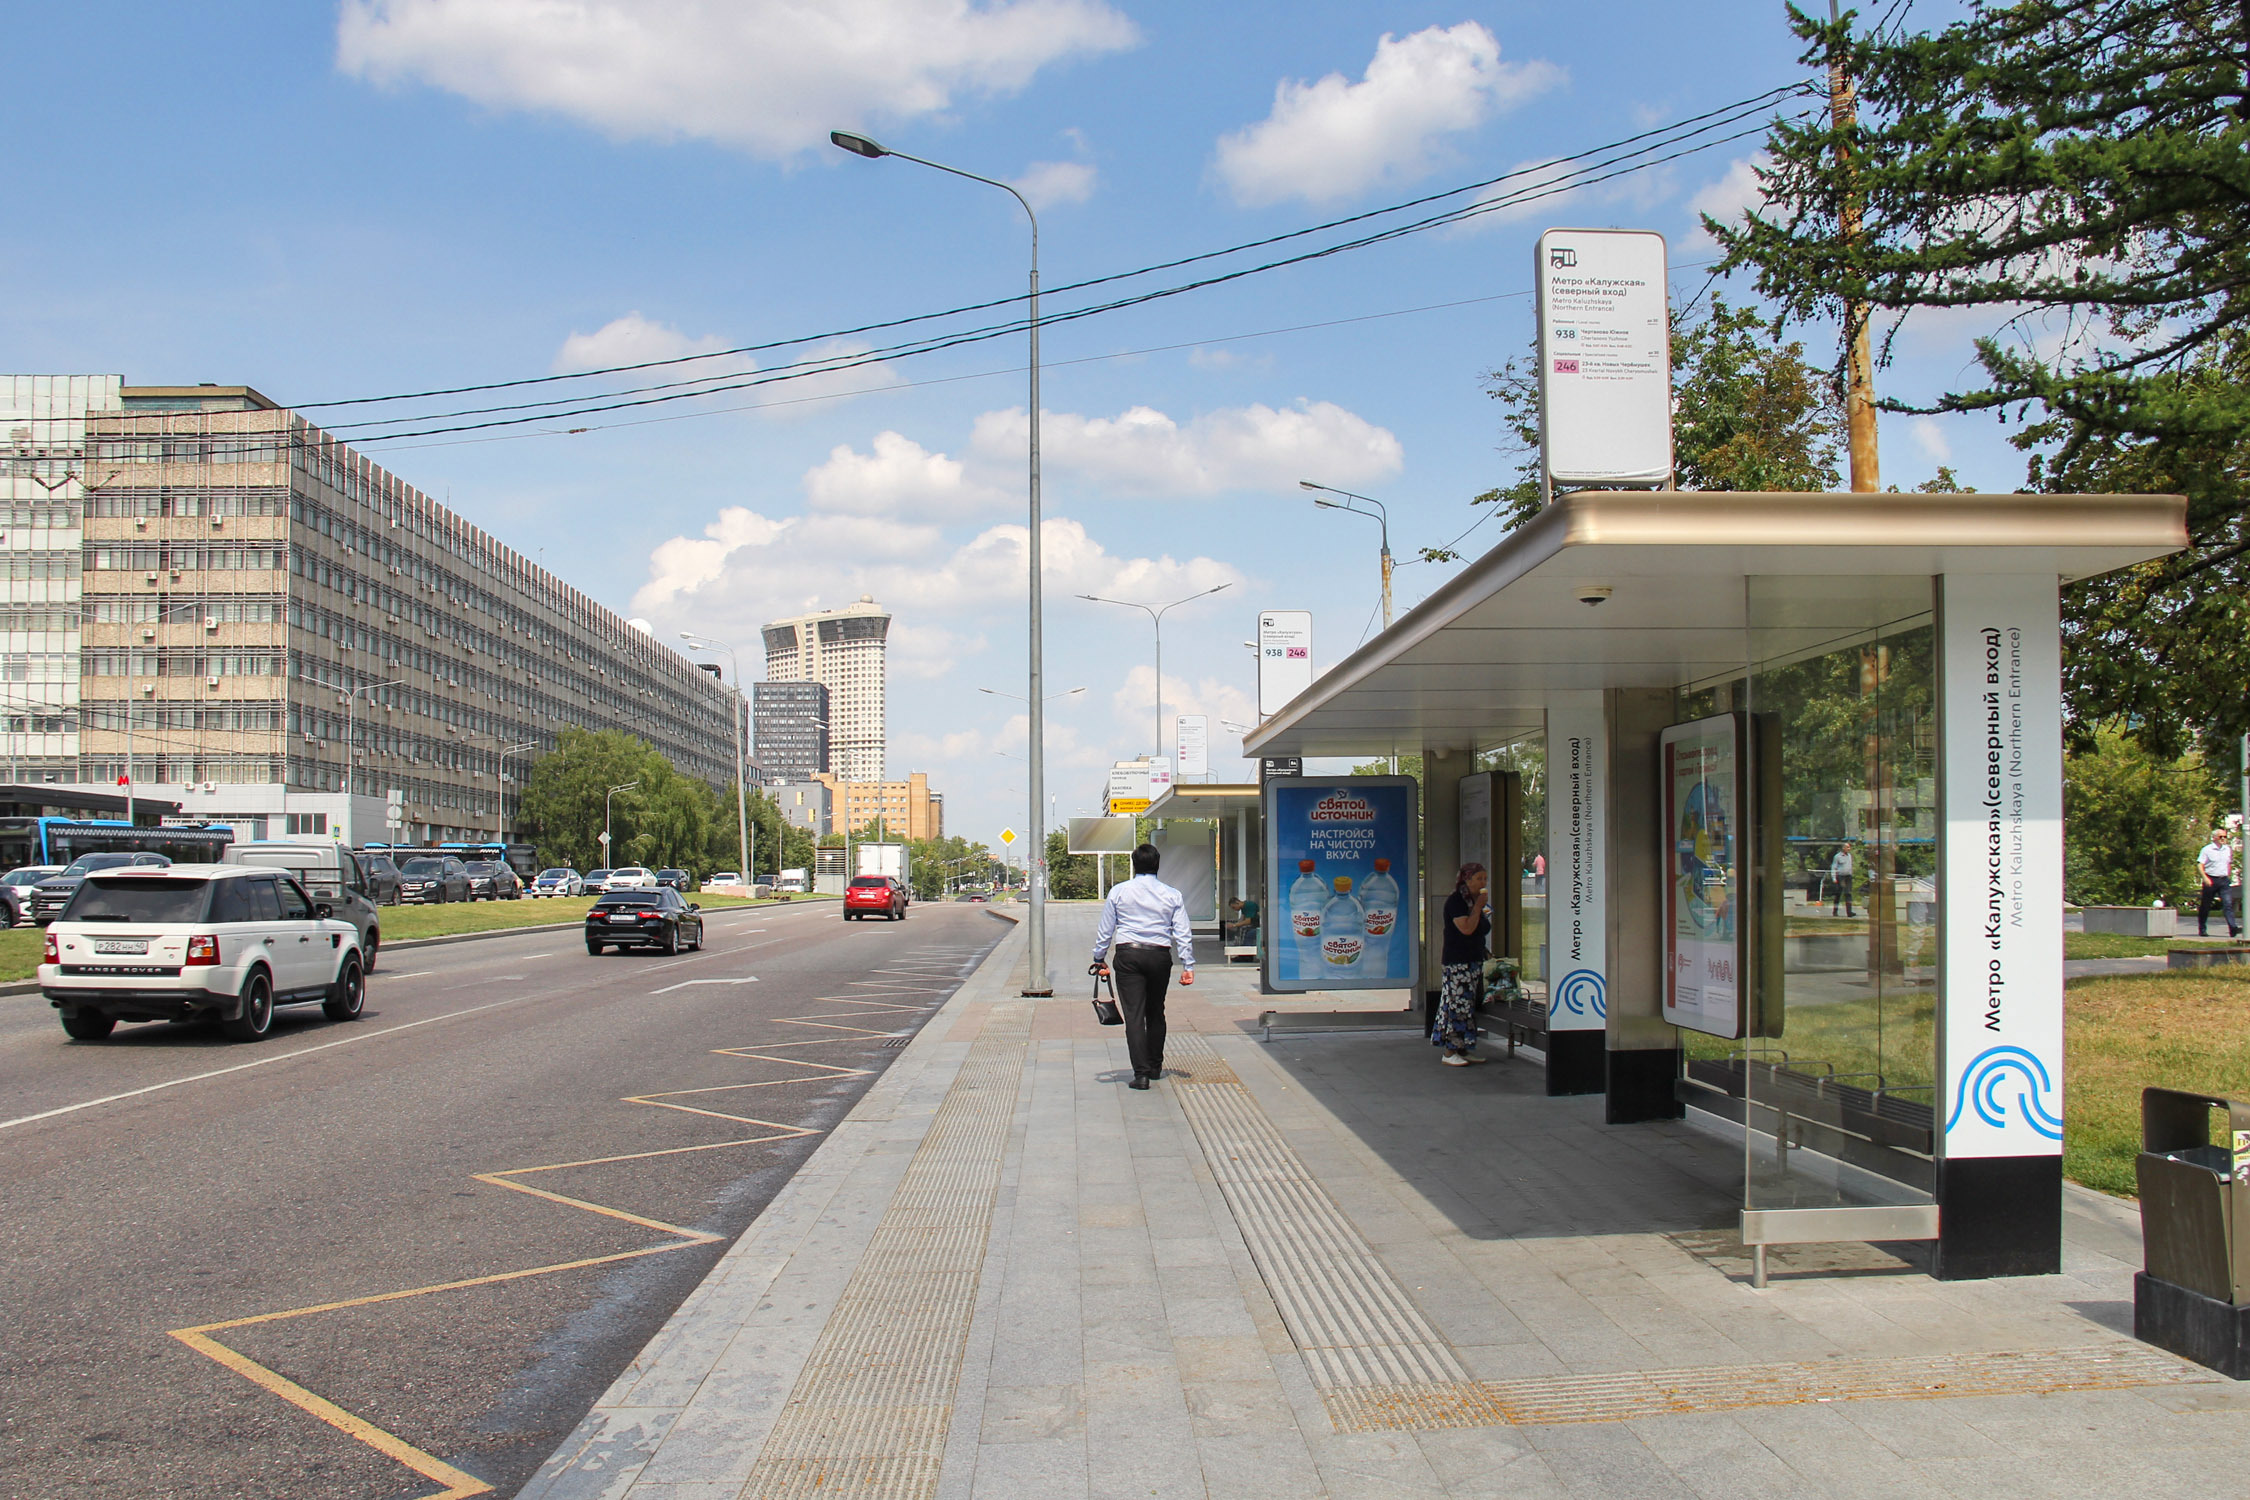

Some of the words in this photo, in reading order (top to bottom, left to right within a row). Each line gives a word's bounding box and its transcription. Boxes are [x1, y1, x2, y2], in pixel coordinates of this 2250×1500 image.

[1551, 277, 1583, 287] Метро
[1585, 277, 1646, 287] «Калужская»
[1551, 286, 1600, 297] (северный
[1602, 287, 1627, 297] вход)
[1573, 298, 1612, 306] Kaluzhskaya
[1555, 329, 1576, 339] 938
[1556, 361, 1577, 371] 246
[1265, 649, 1283, 657] 938
[1288, 649, 1306, 657] 246
[1979, 627, 2002, 684] вход)
[2006, 626, 2022, 698] Entrance)
[1567, 737, 1581, 769] вход)
[2008, 703, 2023, 778] (Northern
[1583, 737, 1592, 777] Entrance)
[1583, 779, 1593, 821] (Northern
[1311, 828, 1374, 839] НАСТРОЙСЯ
[2009, 783, 2025, 875] Kaluzhskaya
[1310, 840, 1325, 849] НА
[1327, 840, 1376, 849] ЧИСТОТУ
[1326, 850, 1360, 860] ВКУСА
[1584, 823, 1594, 875] Kaluzhskaya
[1584, 877, 1593, 903] Metro
[2010, 880, 2023, 928] Metro
[1571, 919, 1583, 961] Метро
[1984, 959, 2006, 1033] Метро
